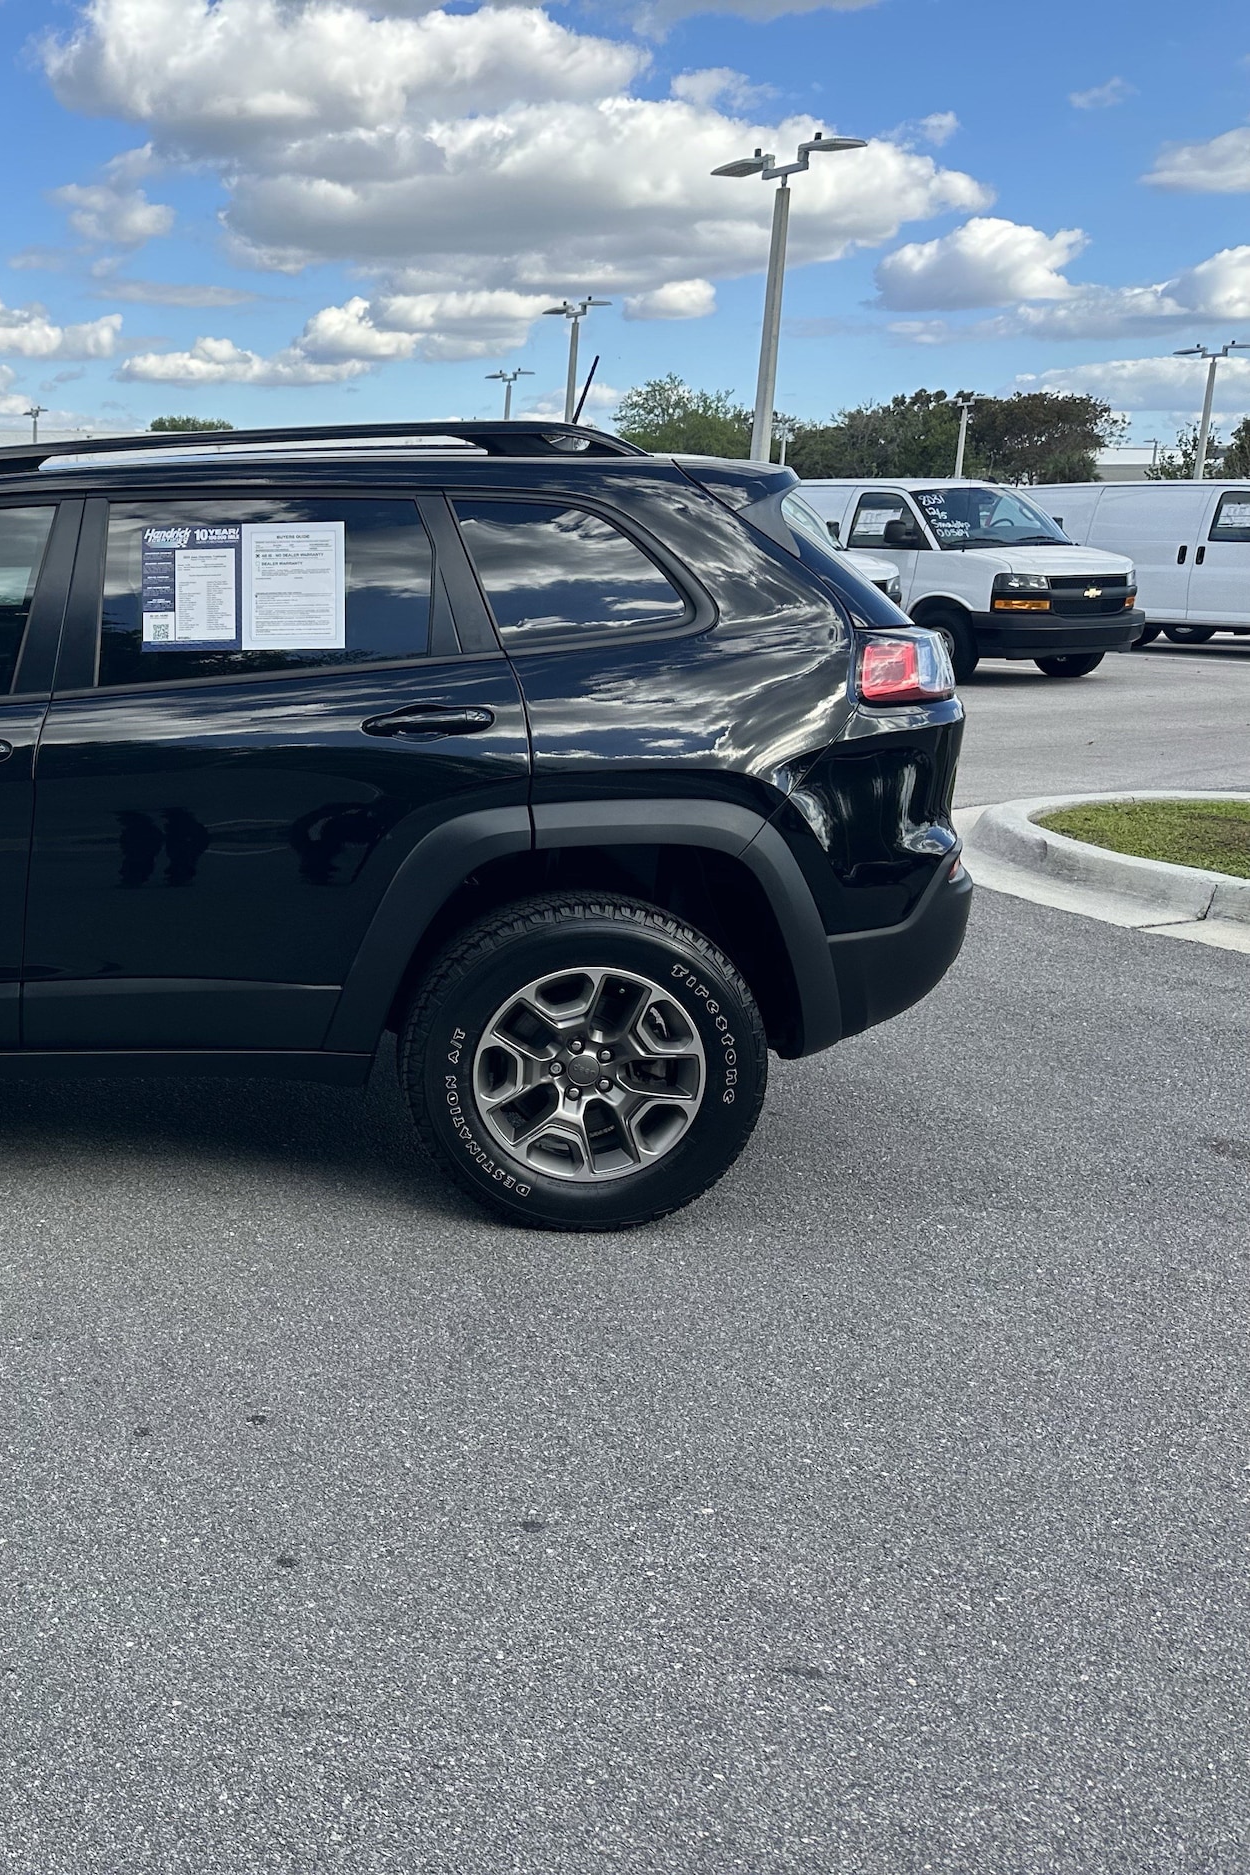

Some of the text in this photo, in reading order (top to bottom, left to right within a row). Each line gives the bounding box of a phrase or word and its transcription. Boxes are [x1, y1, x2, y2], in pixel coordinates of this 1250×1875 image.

[194, 529, 208, 541] 10
[918, 495, 945, 506] 8031
[671, 963, 738, 1105] Firestone
[444, 1027, 531, 1198] DESTINATION A/T
